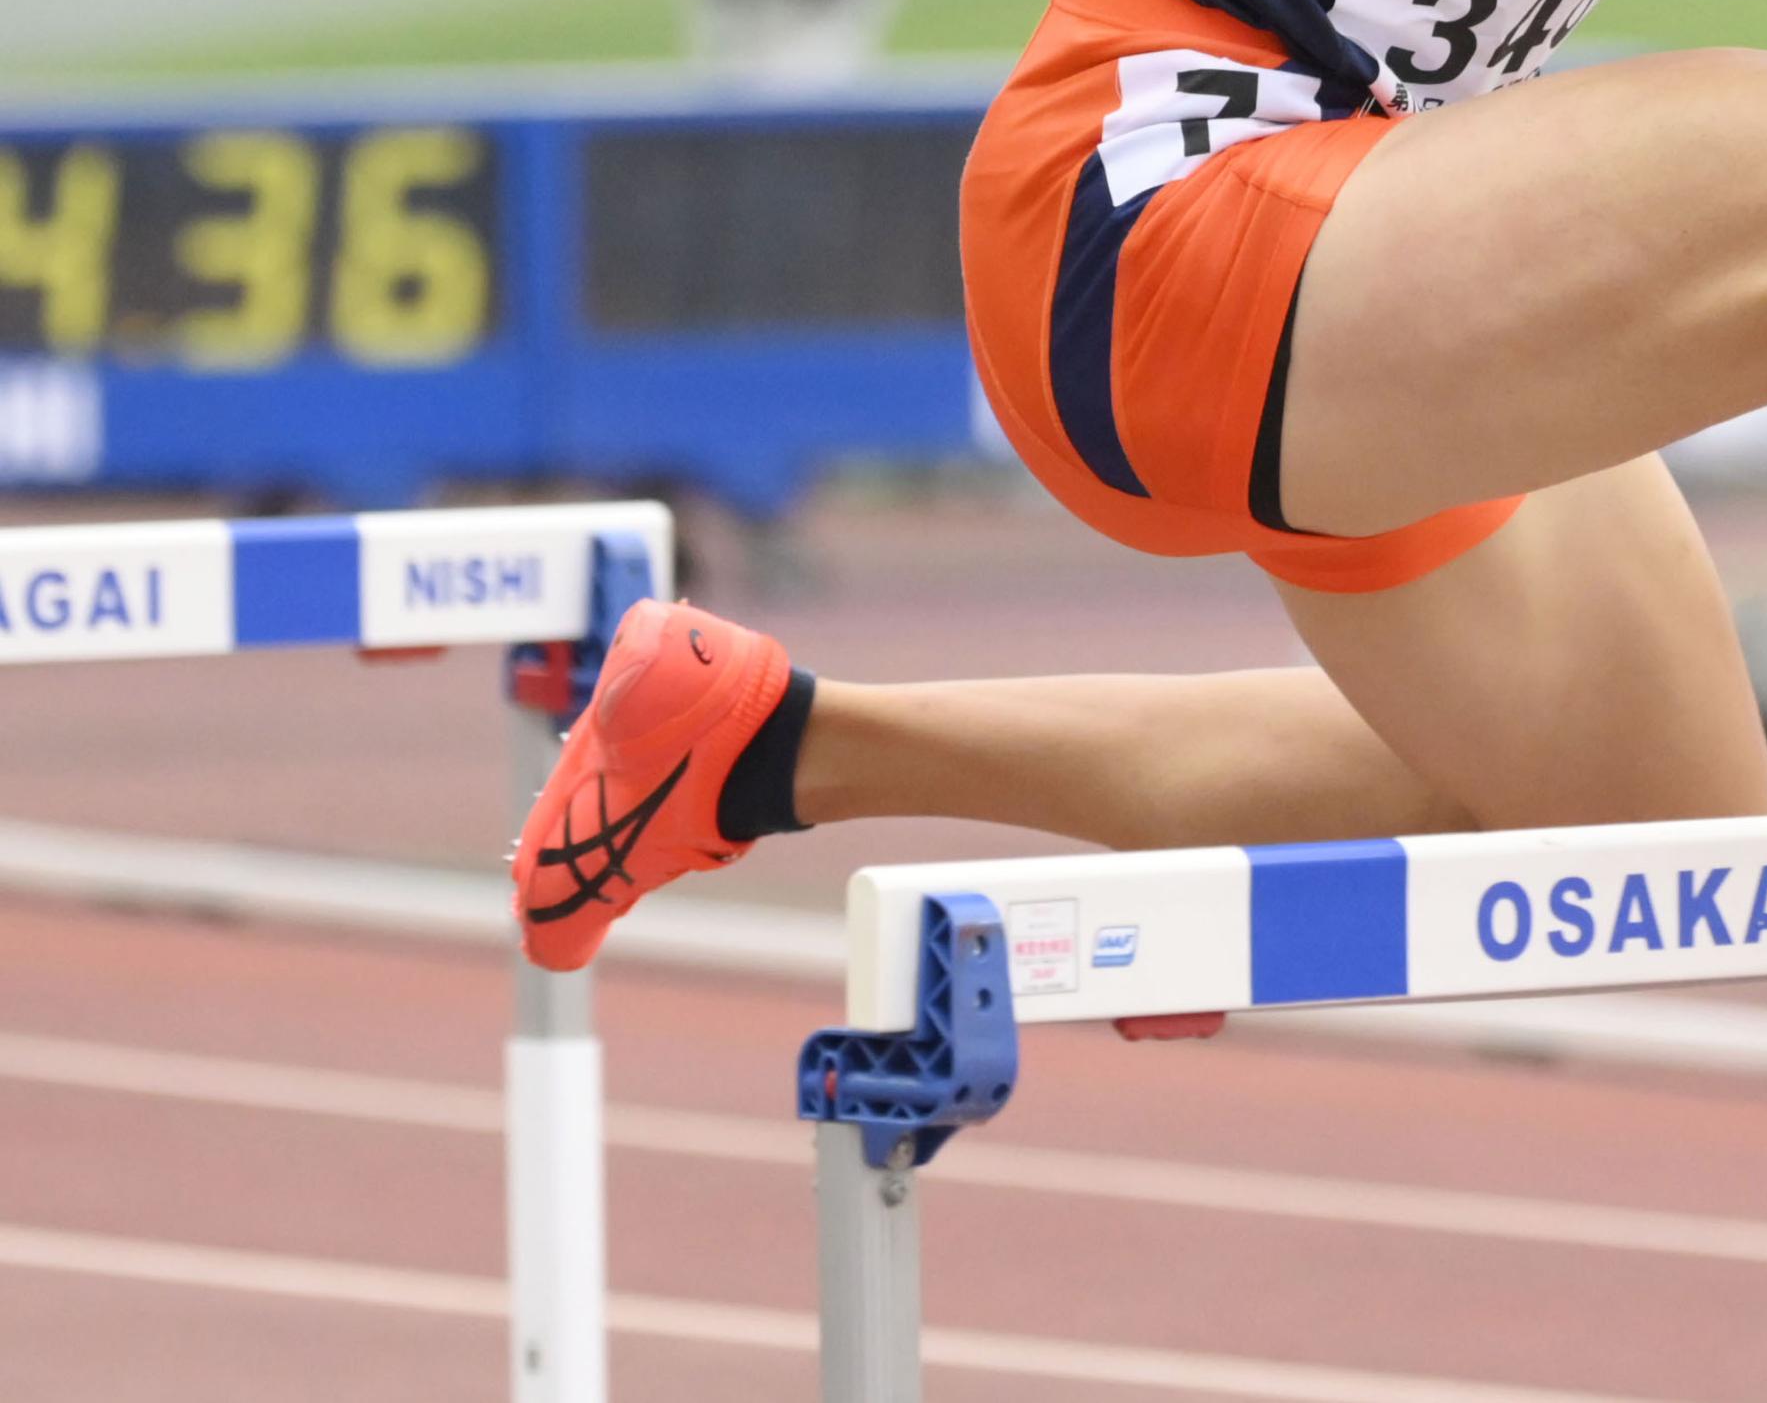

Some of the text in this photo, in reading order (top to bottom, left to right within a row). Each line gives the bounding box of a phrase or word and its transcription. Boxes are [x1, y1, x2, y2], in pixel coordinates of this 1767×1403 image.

[1175, 68, 1259, 157] 7
[0, 568, 161, 633] GAI
[403, 555, 543, 610] NISHI
